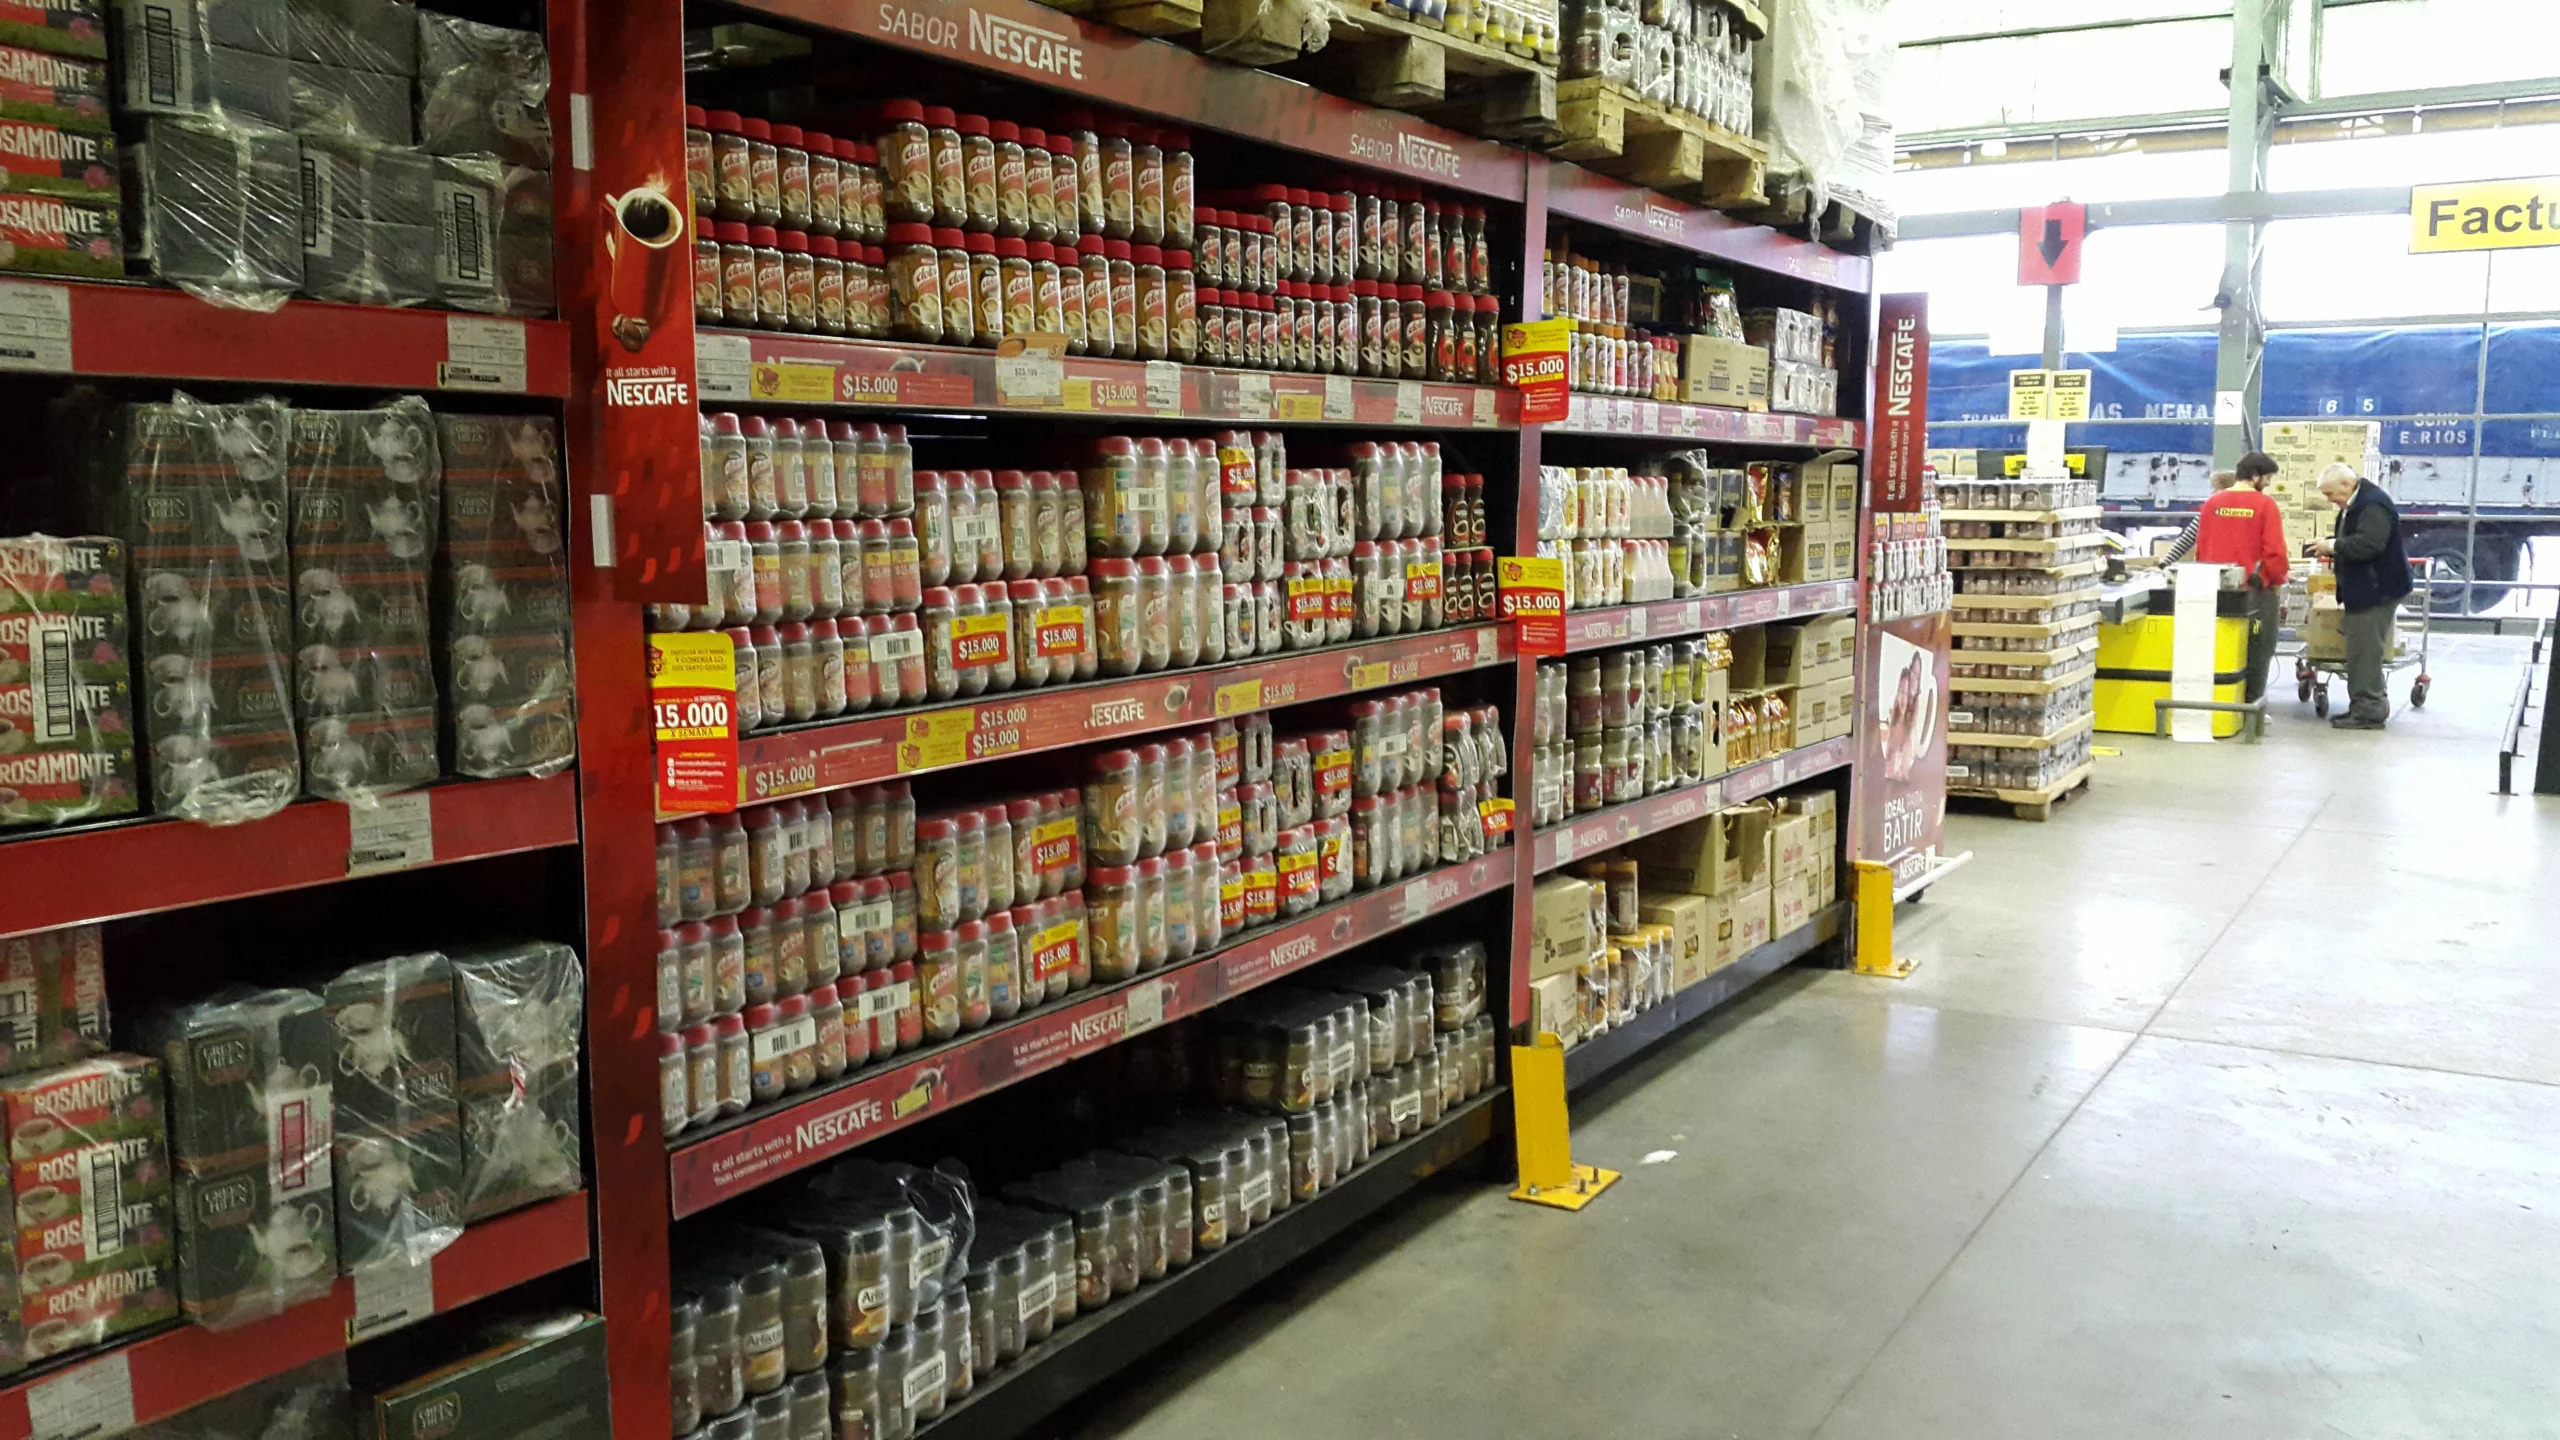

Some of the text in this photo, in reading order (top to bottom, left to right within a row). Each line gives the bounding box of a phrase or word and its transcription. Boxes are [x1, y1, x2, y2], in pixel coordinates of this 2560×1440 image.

[878, 4, 1083, 80] SABOR NESCAFE
[0, 52, 88, 88] SAMONTE
[0, 125, 97, 160] SAMONTE
[1350, 132, 1460, 178] SABOR NESCAFE
[0, 199, 102, 234] OSAMONTE
[606, 365, 676, 377] It all starts with a
[1506, 359, 1565, 385] $15.000
[1887, 318, 1916, 417] NESCAFE
[606, 378, 688, 406] NESCAFE
[843, 374, 898, 399] $15.000
[1097, 384, 1137, 405] $15.000
[1425, 395, 1464, 418] NESCAFE
[2326, 398, 2374, 413] 6 5
[1891, 428, 1899, 448] with
[2399, 430, 2468, 445] E.RIOS
[1889, 449, 1898, 475] starts
[1899, 482, 1907, 500] Todo
[1904, 420, 1910, 429] un
[1886, 492, 1895, 501] It
[1888, 477, 1896, 491] all
[2221, 508, 2252, 517] Diarco
[1503, 595, 1561, 615] $15.000
[1042, 627, 1077, 648] $15.000
[1584, 621, 1612, 640] NESCAFE
[959, 637, 999, 660] $15.000
[1264, 683, 1296, 704] $15.000
[653, 701, 728, 729] 15.000
[980, 706, 1027, 730] $15.000
[670, 727, 713, 738] X SEMANA
[973, 729, 1019, 756] $15.000
[756, 764, 816, 796] $15.000
[1884, 796, 1906, 820] IDEAL
[1580, 828, 1609, 847] NESCAFE
[1883, 808, 1923, 854] BATIR
[1036, 839, 1071, 866] $15.000
[1040, 943, 1071, 972] $15.000
[1270, 935, 1317, 969] NESCAFE
[34, 1073, 143, 1115] ROSAMONTE
[795, 1098, 883, 1153] NESCAFE
[712, 1134, 792, 1173] It all starts with a
[713, 1171, 733, 1187] Todo
[768, 1154, 782, 1168] con
[783, 1150, 793, 1160] un
[48, 1265, 158, 1315] ROSAMONTE
